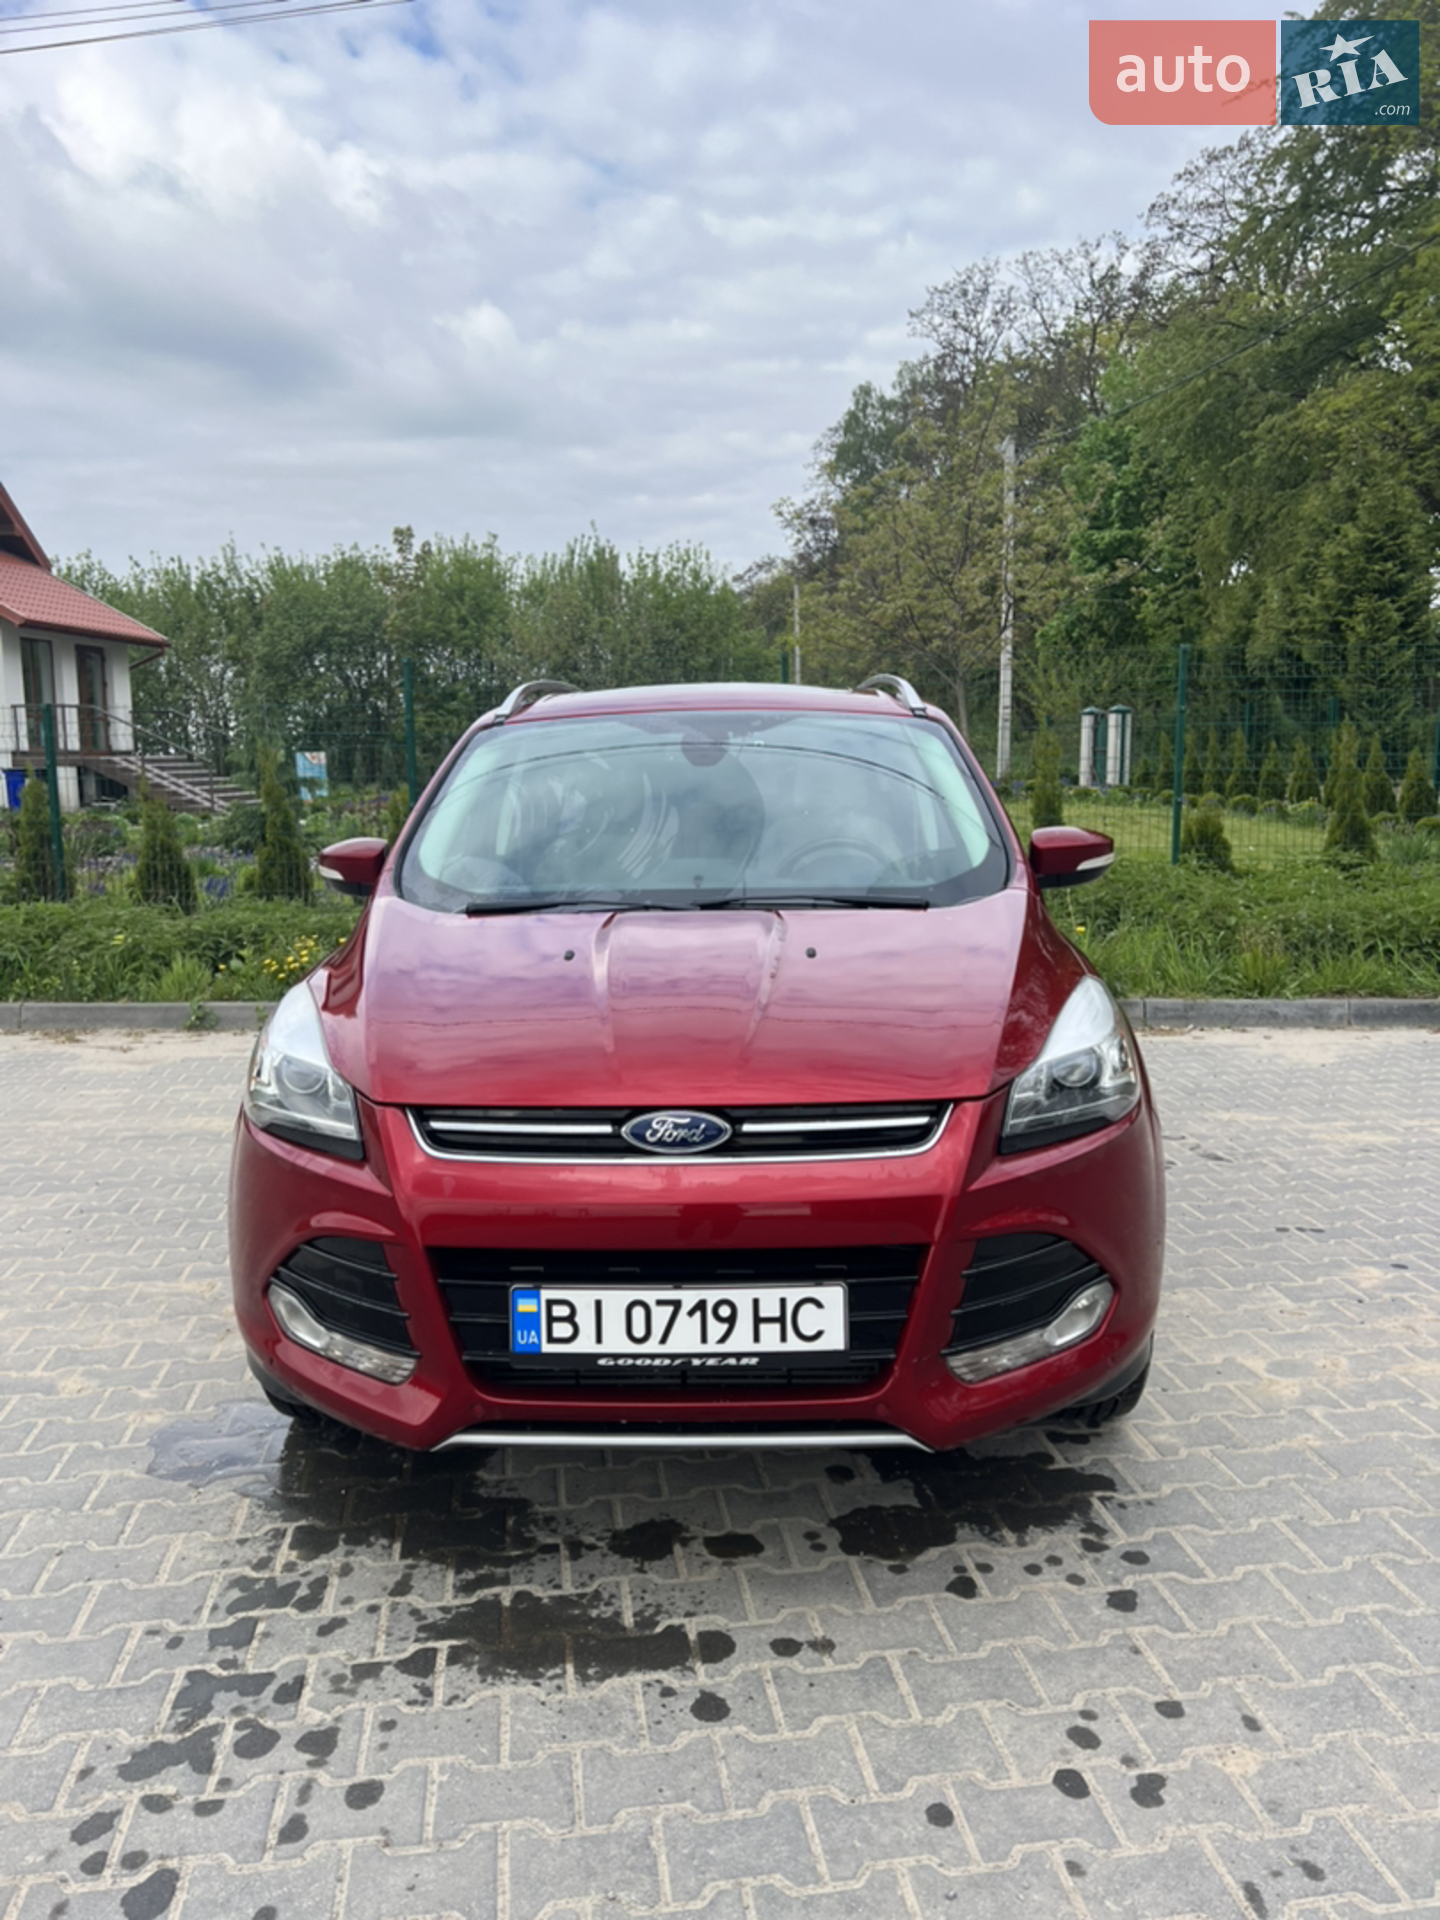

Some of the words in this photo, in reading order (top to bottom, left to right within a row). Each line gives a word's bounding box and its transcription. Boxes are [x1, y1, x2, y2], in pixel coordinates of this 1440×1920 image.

[645, 1116, 706, 1142] Ford
[545, 1298, 603, 1345] BI
[625, 1298, 738, 1346] 0719
[752, 1296, 826, 1344] HC
[517, 1330, 539, 1345] UA
